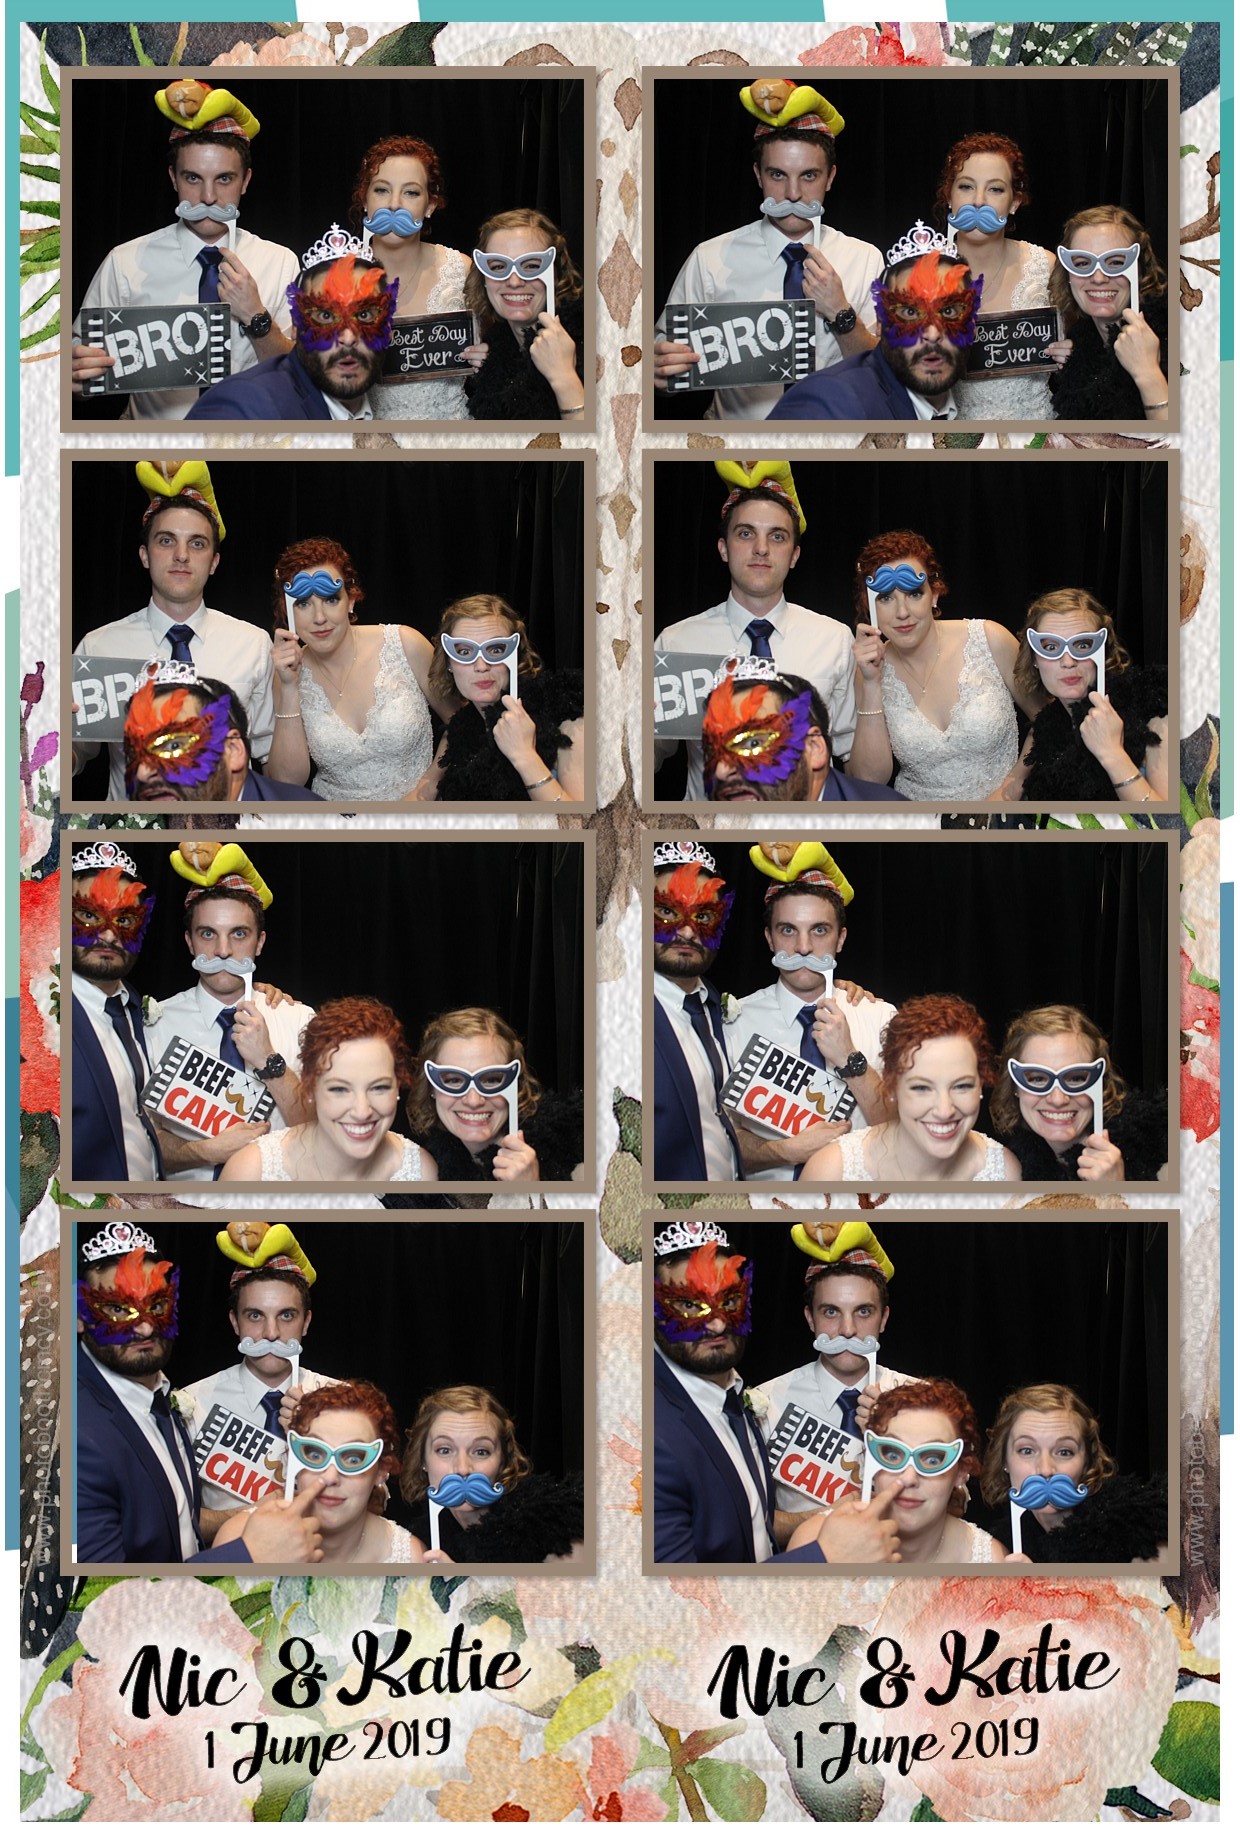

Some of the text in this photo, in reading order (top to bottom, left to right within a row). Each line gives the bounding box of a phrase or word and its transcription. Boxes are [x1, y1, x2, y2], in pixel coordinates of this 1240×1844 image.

[104, 311, 209, 379] BRO
[389, 325, 468, 347] Best Day
[689, 307, 794, 375] BRO
[973, 321, 1052, 343] Best Day
[984, 341, 1037, 368] Ever
[400, 344, 452, 372] Ever
[72, 672, 137, 726] BR
[654, 668, 716, 723] BR
[179, 1049, 236, 1097] BEEF
[759, 1047, 817, 1096] BEEF
[219, 1416, 275, 1463] BEEF
[794, 1416, 851, 1464] BEEF
